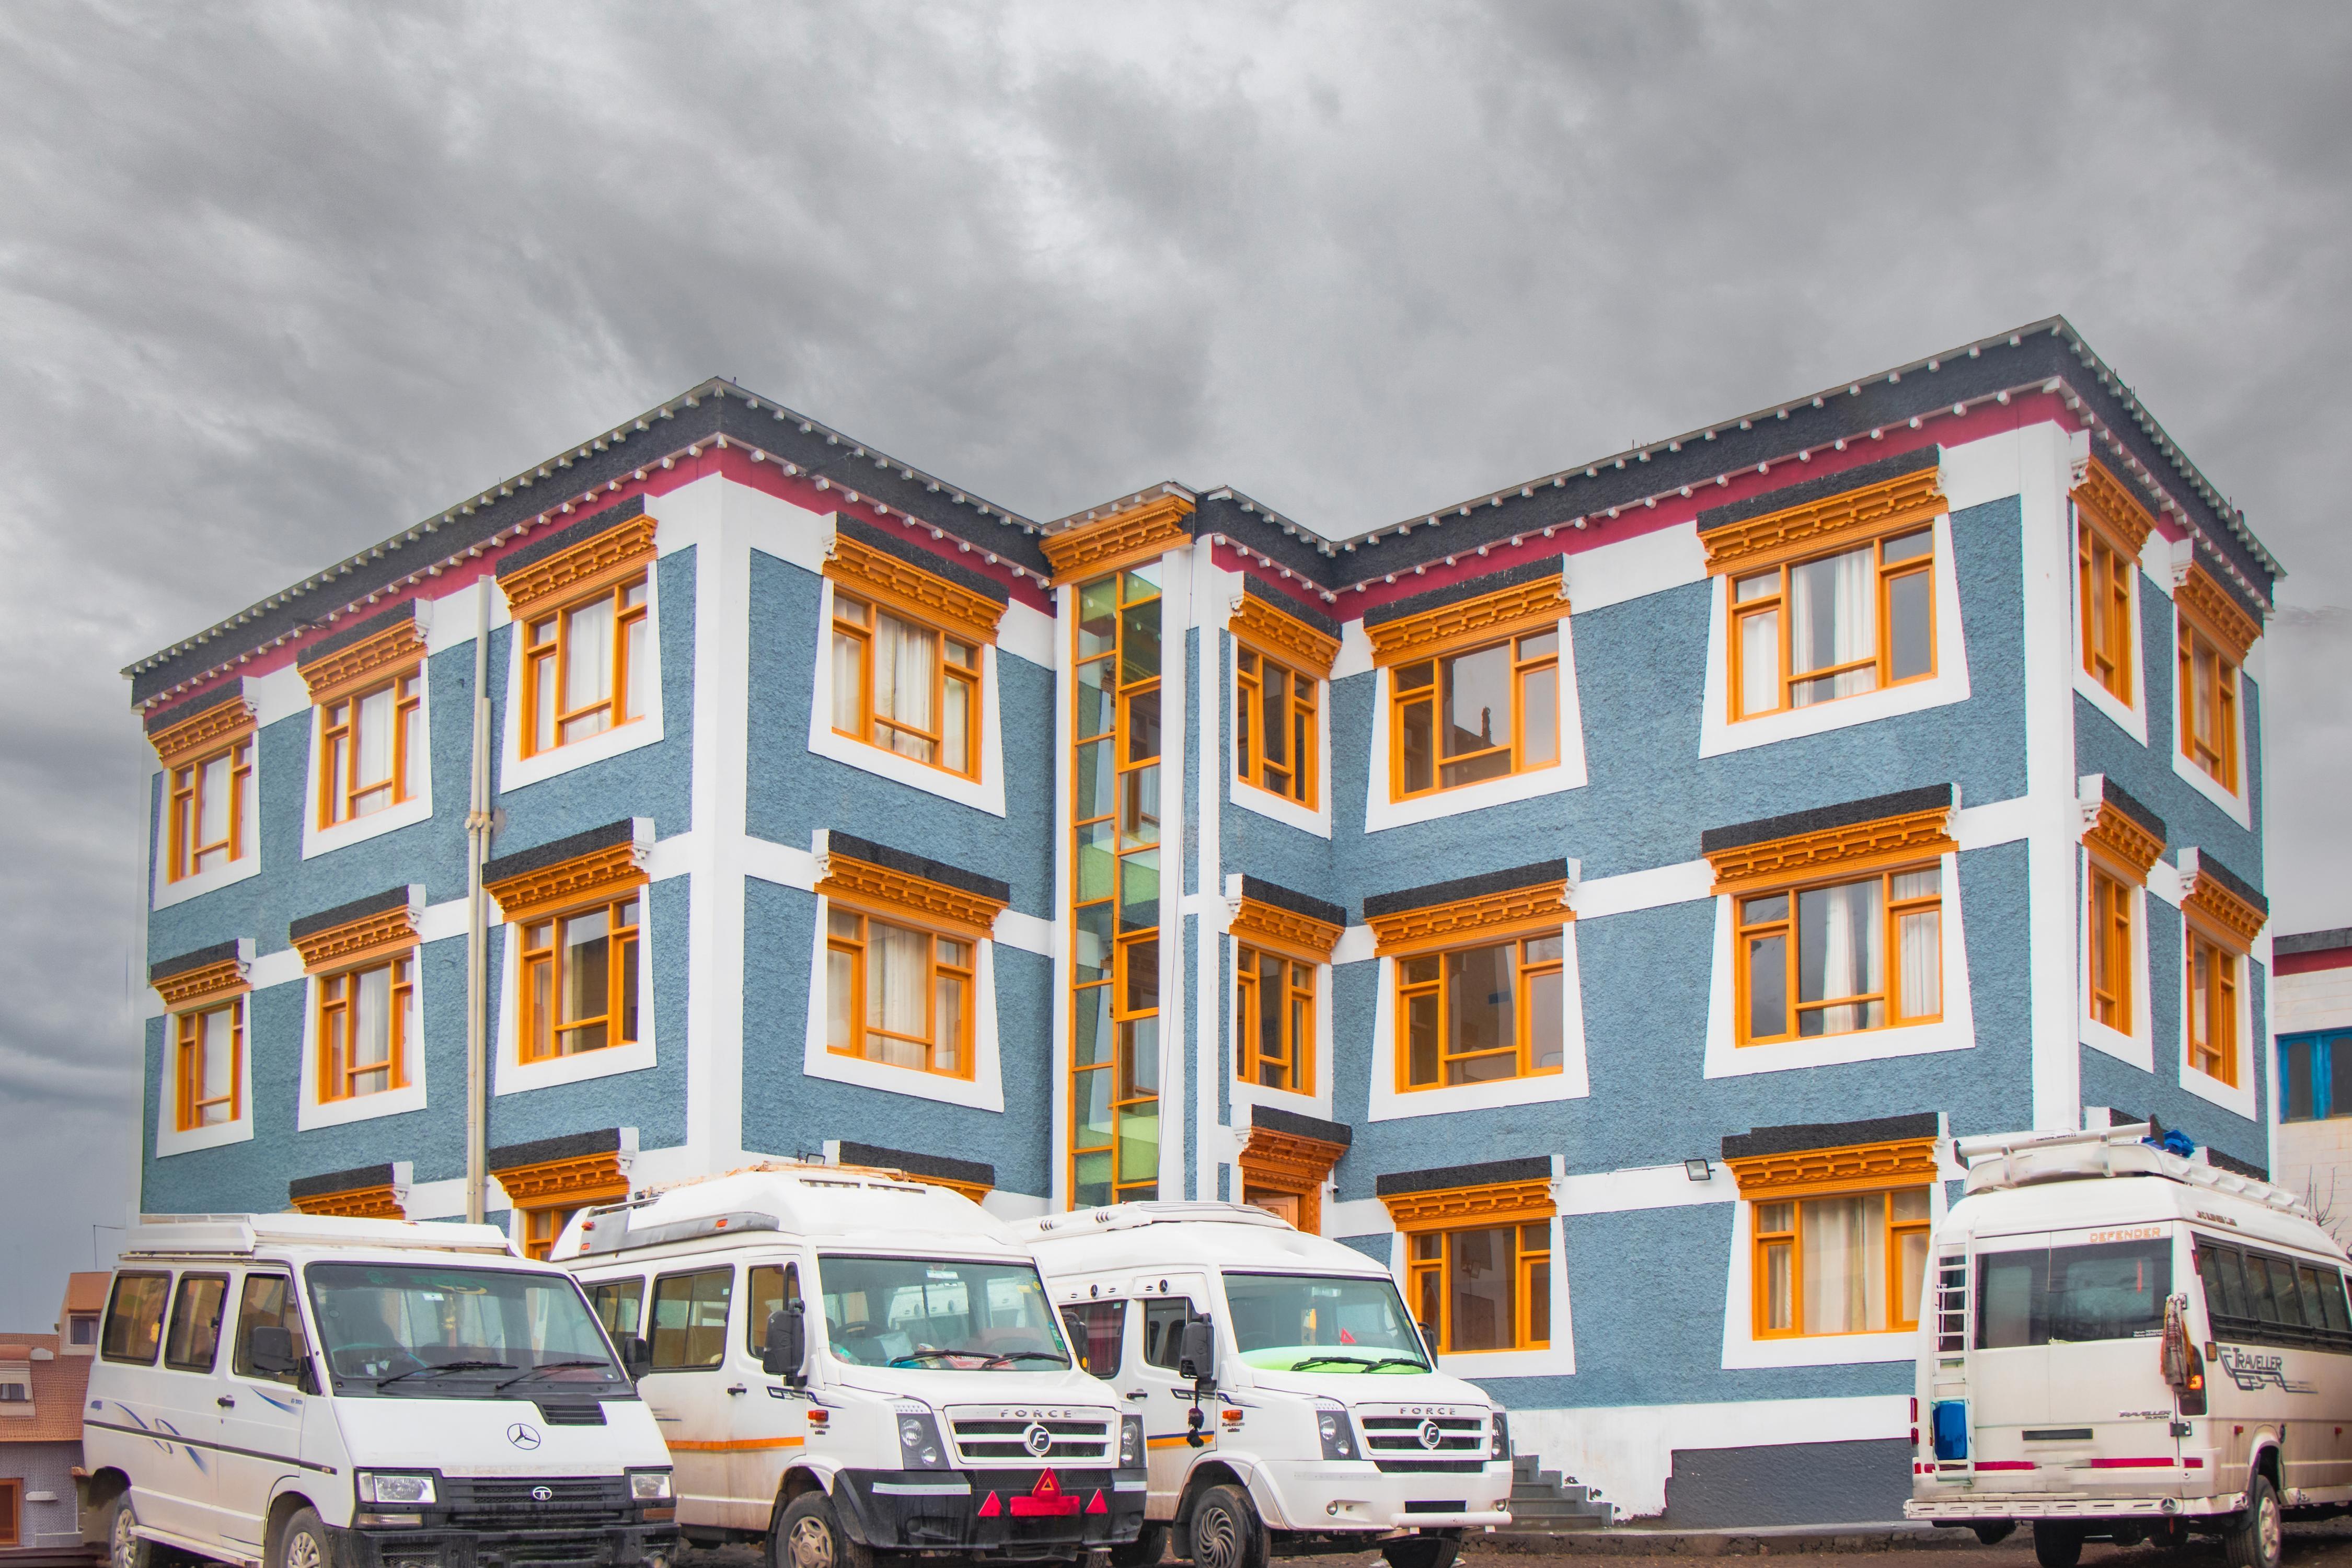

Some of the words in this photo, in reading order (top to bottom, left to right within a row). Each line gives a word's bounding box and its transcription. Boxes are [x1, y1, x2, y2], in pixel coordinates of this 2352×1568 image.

[2090, 1227, 2161, 1243] DEFENDER
[2232, 1347, 2282, 1370] TRAVELLER
[1000, 1409, 1071, 1418] FORCE
[1400, 1407, 1456, 1415] FORCE
